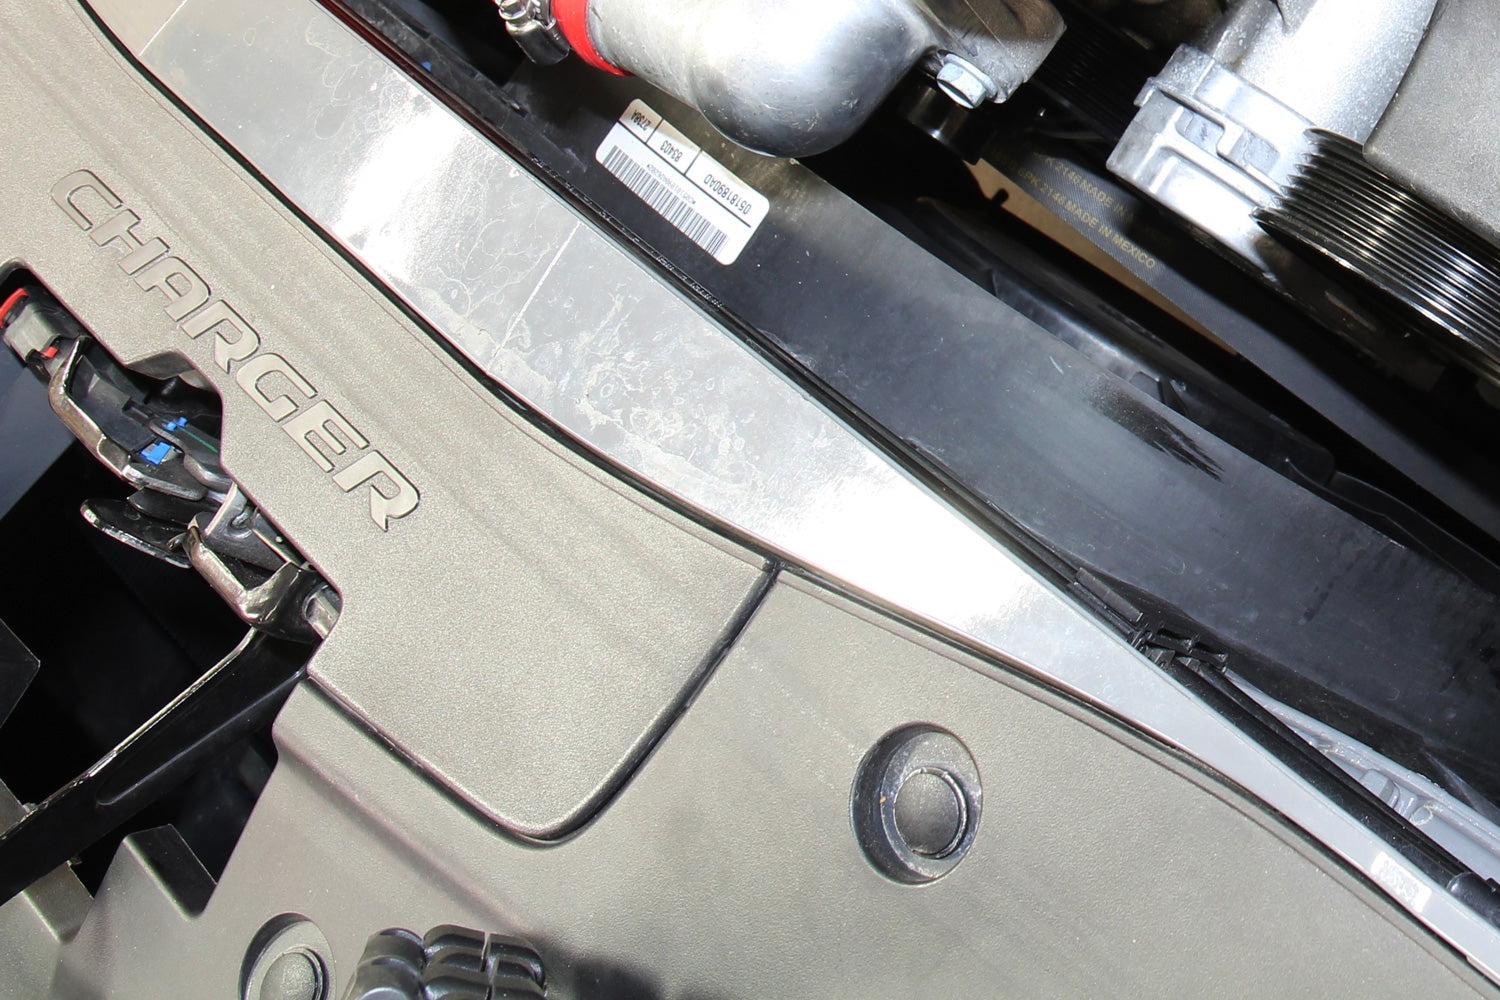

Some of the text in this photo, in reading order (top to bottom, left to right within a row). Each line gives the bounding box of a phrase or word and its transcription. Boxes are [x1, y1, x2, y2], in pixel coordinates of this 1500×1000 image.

[659, 138, 685, 163] 83403
[703, 172, 753, 216] 05181890AD
[1065, 199, 1098, 229] MADE
[1097, 220, 1113, 239] IN
[1111, 233, 1157, 270] MEXICO
[49, 168, 421, 533] CHARGER
